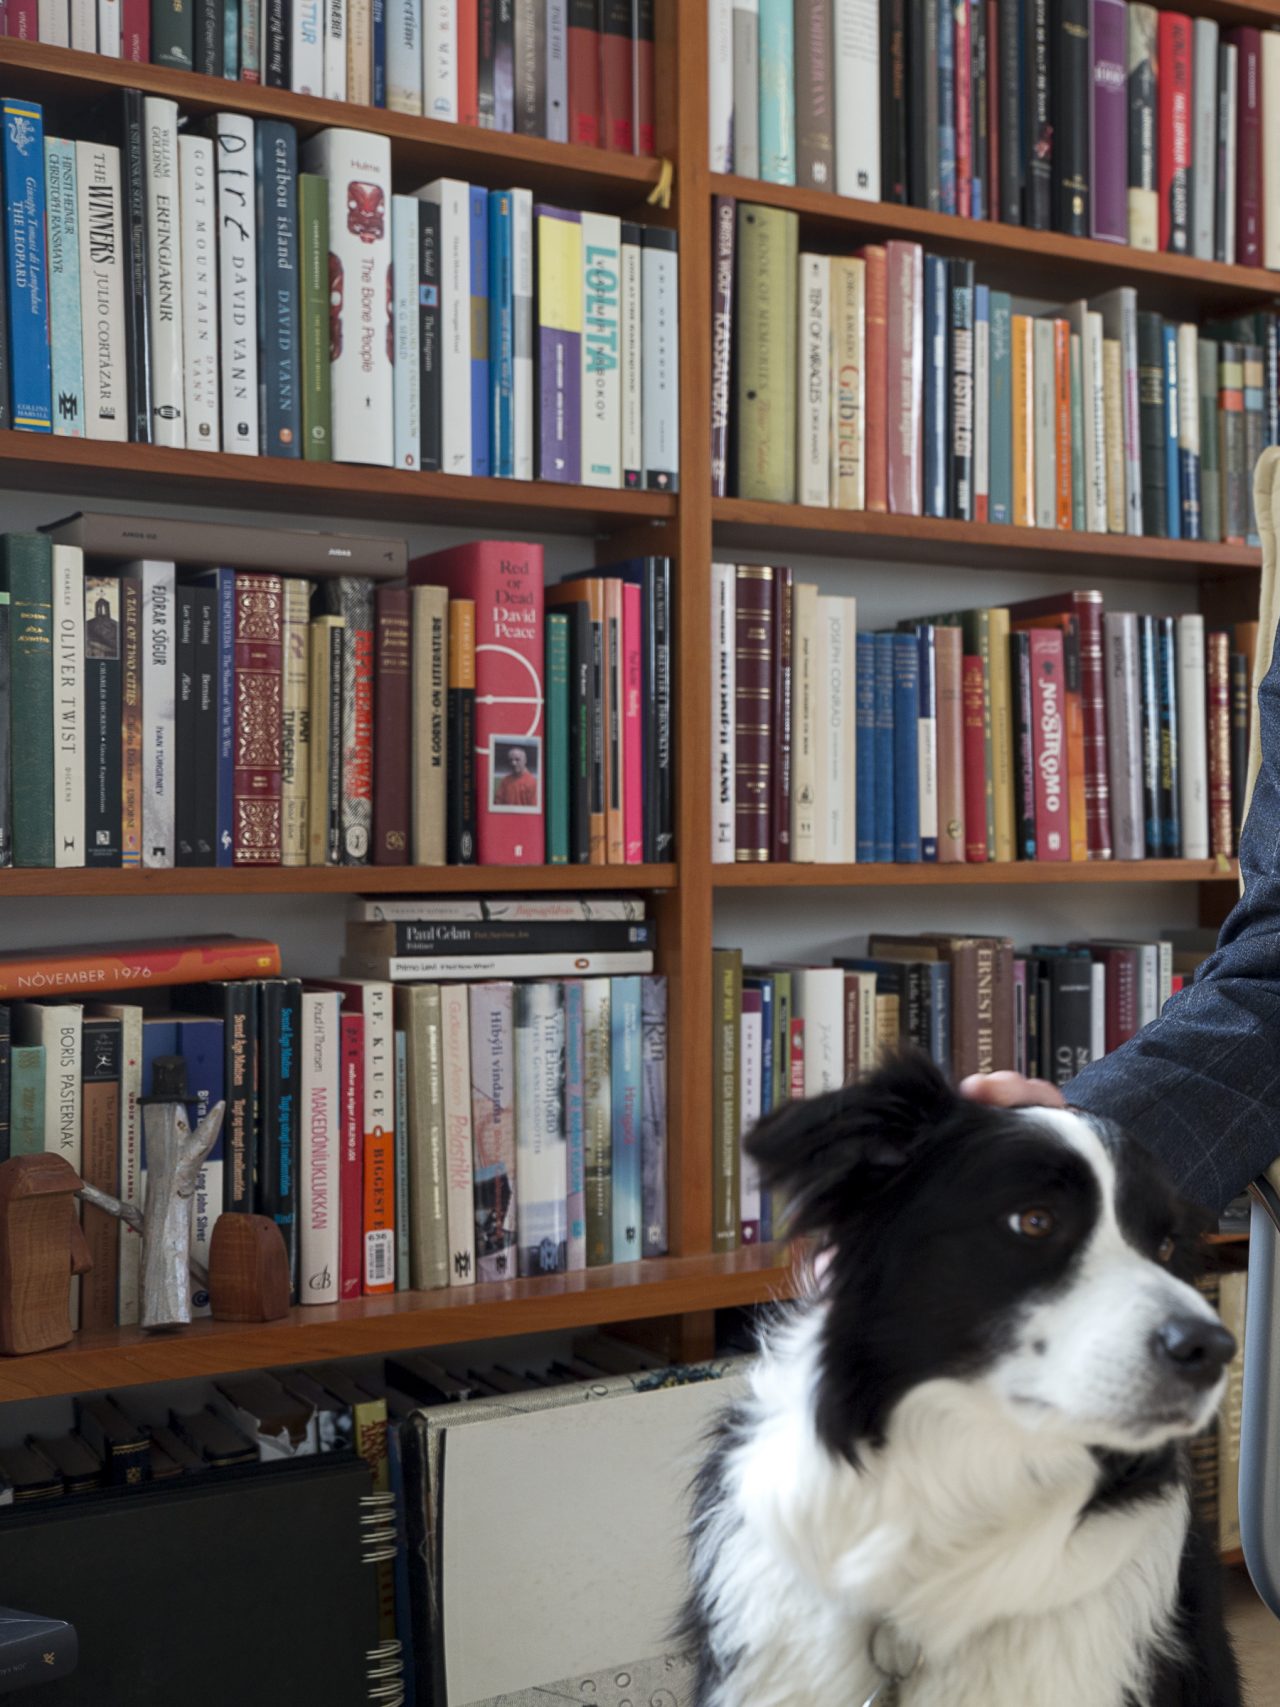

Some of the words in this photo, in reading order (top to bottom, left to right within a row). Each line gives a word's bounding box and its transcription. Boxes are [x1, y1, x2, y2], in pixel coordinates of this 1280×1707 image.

[93, 154, 106, 183] THE
[152, 126, 162, 178] GOLDING
[162, 129, 171, 178] WILLIAM
[350, 160, 380, 174] Hulme
[49, 154, 60, 212] CHRISTOPH
[62, 156, 72, 191] HINSTI
[194, 150, 206, 206] GOAT
[275, 138, 291, 208] caribou
[13, 200, 24, 226] THE
[24, 176, 38, 216] Giuseppe
[62, 192, 75, 234] HEIMUR
[51, 214, 63, 274] RANSMAYR
[88, 185, 115, 265] WINNERS
[276, 216, 293, 270] island
[719, 206, 732, 254] CHRISTA
[14, 229, 27, 288] LEOPARD
[29, 253, 40, 264] di
[156, 194, 173, 322] ERFINGJARNIR
[361, 258, 374, 283] The
[758, 234, 770, 276] BOOK
[26, 265, 41, 314] Lampedusa
[94, 270, 110, 315] JULIO
[196, 221, 208, 342] MOUNTAIN
[232, 256, 248, 326] DAVID
[596, 260, 606, 333] VLADIMIR
[718, 260, 730, 298] WOLF
[758, 283, 770, 300] OF
[844, 270, 855, 308] JORGE
[277, 290, 292, 350] DAVID
[360, 287, 374, 322] Bone
[585, 244, 618, 374] LOLITA
[810, 288, 822, 318] TENT
[359, 326, 375, 372] People
[758, 307, 770, 391] MEMORIES
[810, 321, 822, 342] OF
[845, 314, 855, 358] AMADO
[96, 320, 114, 400] CORTÁZAR
[231, 338, 248, 400] VANN
[712, 312, 732, 428] KASSANDRA
[810, 345, 822, 404] MIRACLES
[192, 358, 202, 402] VANN
[205, 355, 215, 408] DAVID
[278, 359, 292, 412] VANN
[596, 347, 606, 421] NABOKOV
[838, 364, 860, 478] Gabriela
[64, 568, 72, 606] CHARLES
[500, 560, 529, 575] Red
[506, 580, 522, 590] or
[152, 586, 169, 626] FJÓRAR
[222, 580, 231, 601] LUIS
[495, 589, 534, 605] Dead
[126, 598, 137, 624] TALE
[493, 606, 536, 624] David
[126, 626, 137, 646] OF
[152, 628, 170, 666] SÖGUR
[494, 622, 536, 640] Peace
[828, 618, 840, 664] JOSEPH
[60, 619, 75, 688] OLIVER
[126, 646, 137, 670] TWO
[431, 616, 442, 690] LITERATURE
[126, 670, 137, 706] CITIES
[182, 672, 190, 700] Æska
[201, 674, 210, 710] Bernska
[223, 669, 231, 697] Shadow
[830, 668, 841, 728] CONRAD
[62, 697, 76, 754] TWIST
[223, 706, 231, 725] What
[155, 726, 163, 748] IVAN
[282, 710, 294, 784] TURGENEV
[1038, 679, 1062, 812] NOSTROMO
[64, 767, 72, 803] DICKENS
[155, 750, 164, 796] TURGENEV
[126, 789, 135, 828] USBORNE
[406, 926, 435, 941] Paul
[436, 925, 471, 940] Celan
[18, 969, 106, 988] NÓVEMBER
[113, 967, 152, 981] 1976
[396, 963, 420, 971] Primo
[724, 970, 733, 996] PHILIP
[977, 950, 992, 1021] ERNEST
[314, 1002, 324, 1024] Knud
[372, 991, 384, 1006] P.
[724, 998, 733, 1020] ROTH
[233, 1014, 246, 1038] Svend
[281, 1008, 293, 1031] Svend
[372, 1012, 384, 1026] F.
[490, 1011, 504, 1057] Híbýli
[544, 1012, 558, 1043] Yfir
[60, 1028, 75, 1067] BORIS
[280, 1050, 292, 1079] Madsen
[314, 1034, 324, 1072] Thomsen
[233, 1055, 245, 1086] Madsen
[372, 1037, 384, 1117] KLUGE
[792, 1060, 804, 1084] PHILIP
[60, 1074, 74, 1149] PASTERNAK
[128, 1092, 136, 1120] UNDIR
[491, 1061, 504, 1124] vindanna
[312, 1087, 330, 1230] MAKEDÓNÍUKLUKKAN
[448, 1114, 470, 1191] Pelastikk
[373, 1149, 385, 1214] BIGGEST
[196, 1192, 208, 1214] John
[196, 1216, 208, 1242] Silver
